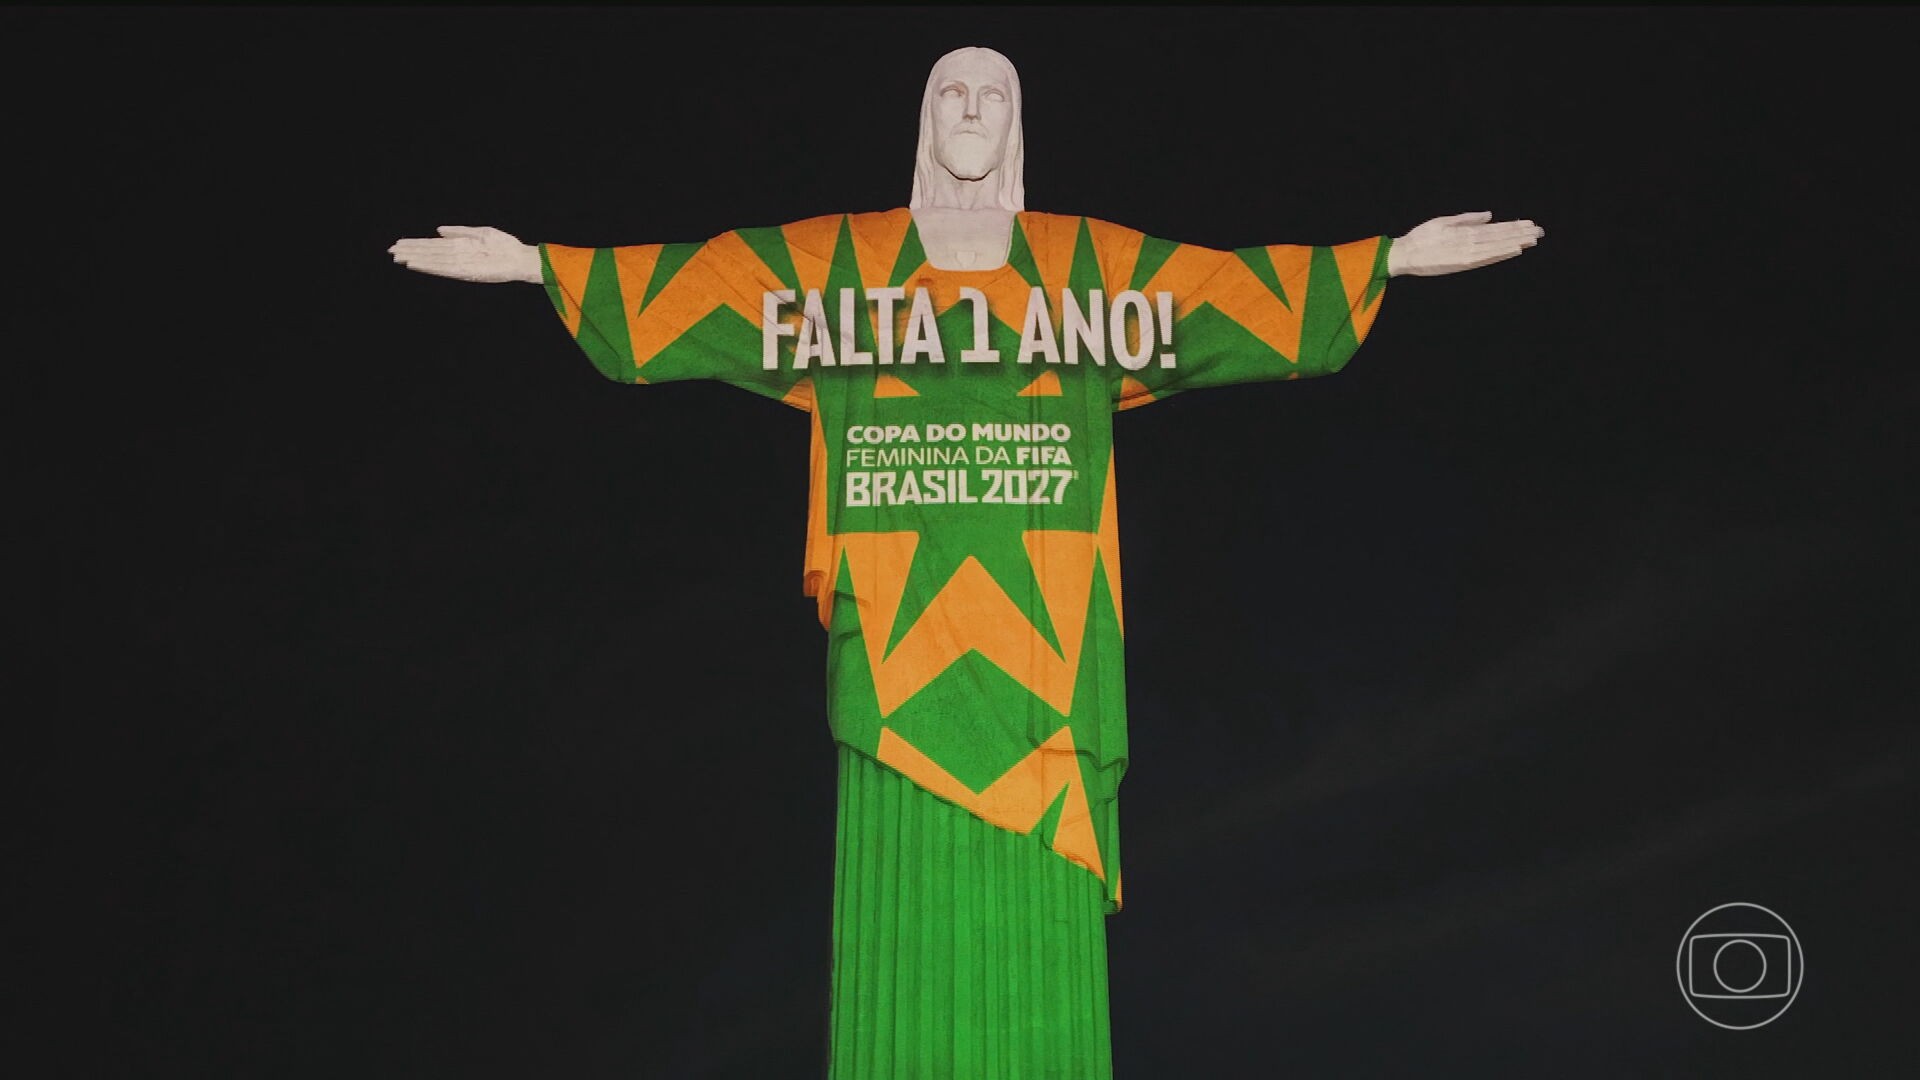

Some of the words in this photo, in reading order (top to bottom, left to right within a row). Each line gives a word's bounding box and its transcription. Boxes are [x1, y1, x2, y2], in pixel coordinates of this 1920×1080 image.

[762, 287, 945, 370] FALTA
[959, 287, 1000, 363] 1
[1016, 286, 1177, 371] ANO!
[846, 425, 920, 444] COPA
[926, 423, 966, 442] DO
[972, 423, 1071, 442] MUNDO
[846, 446, 969, 467] FEMININA
[975, 446, 1010, 465] DA
[1016, 446, 1071, 465] FIFA
[846, 469, 978, 507] BRASIL
[981, 469, 1074, 505] 2027
